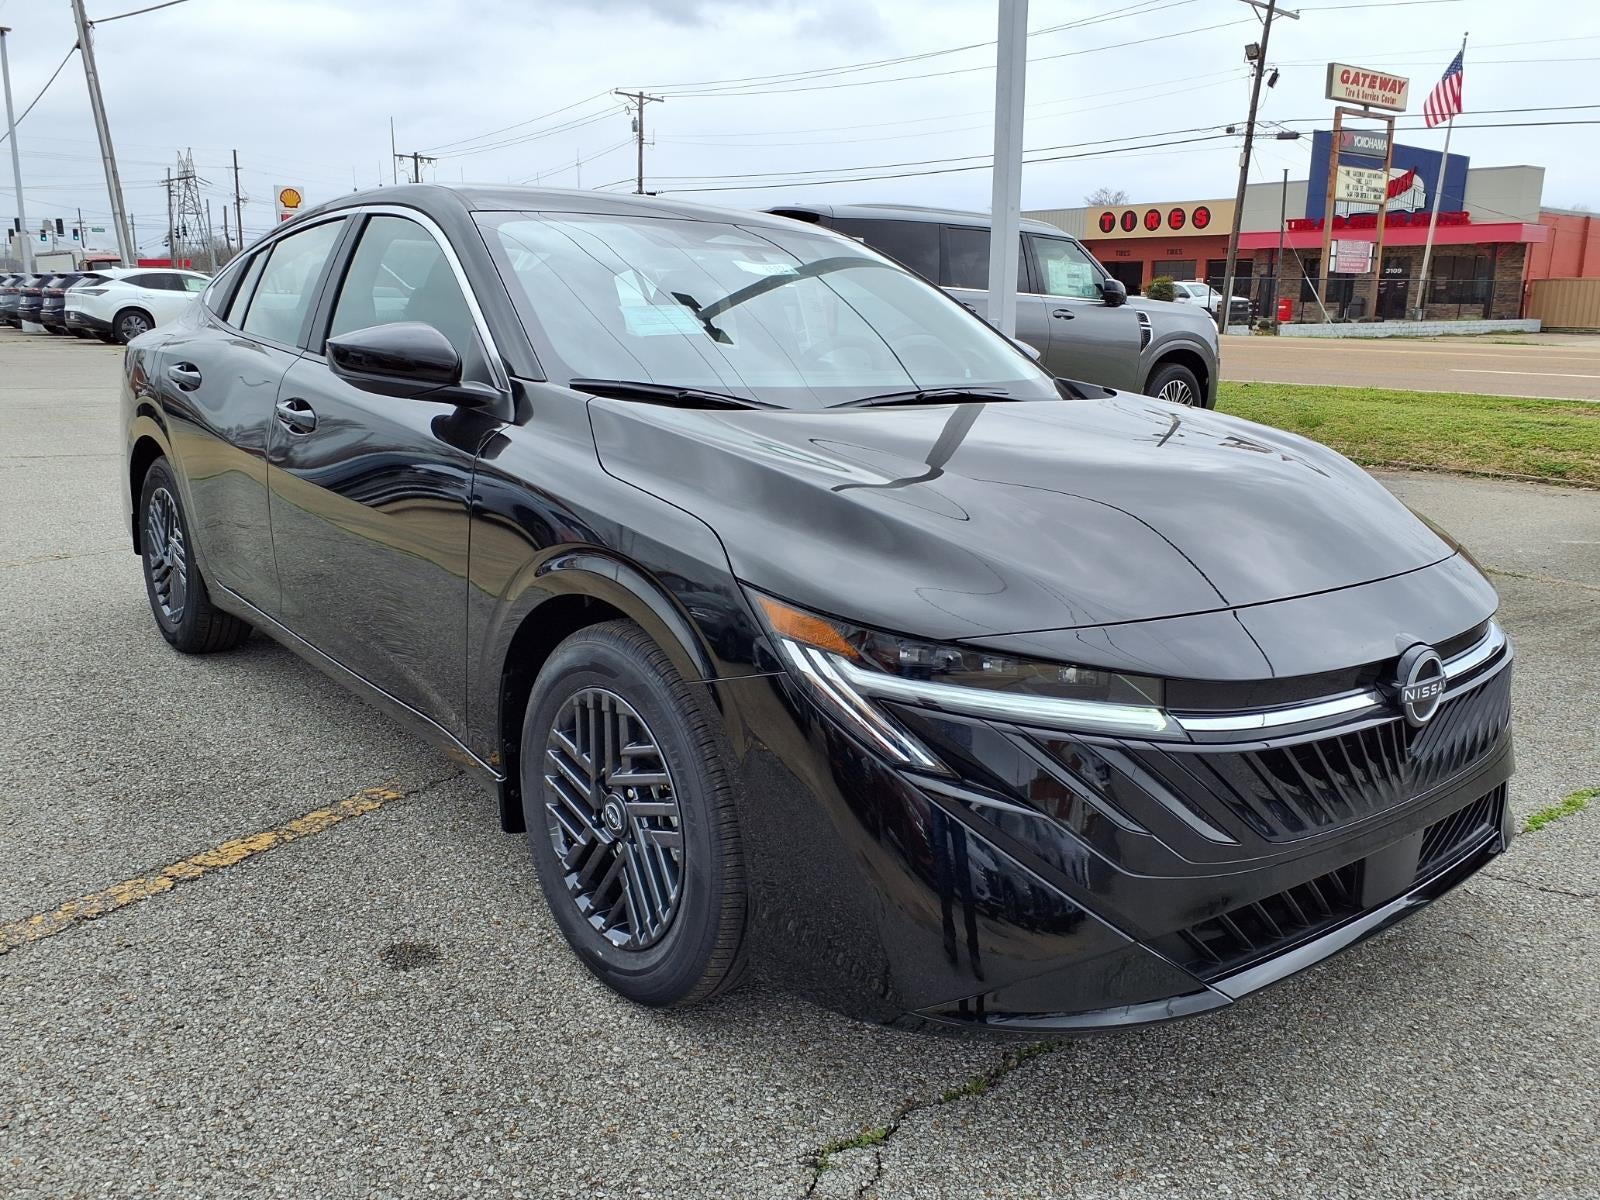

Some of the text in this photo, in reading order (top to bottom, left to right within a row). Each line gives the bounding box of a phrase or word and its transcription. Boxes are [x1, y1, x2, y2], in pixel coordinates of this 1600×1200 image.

[1341, 69, 1407, 95] GATEWAY
[1345, 87, 1355, 97] Tire
[1362, 89, 1380, 102] Service
[1381, 94, 1397, 105] Center
[1353, 135, 1388, 151] YOKOHAMA
[1101, 208, 1208, 231] TIRES
[1166, 248, 1183, 256] TIRES
